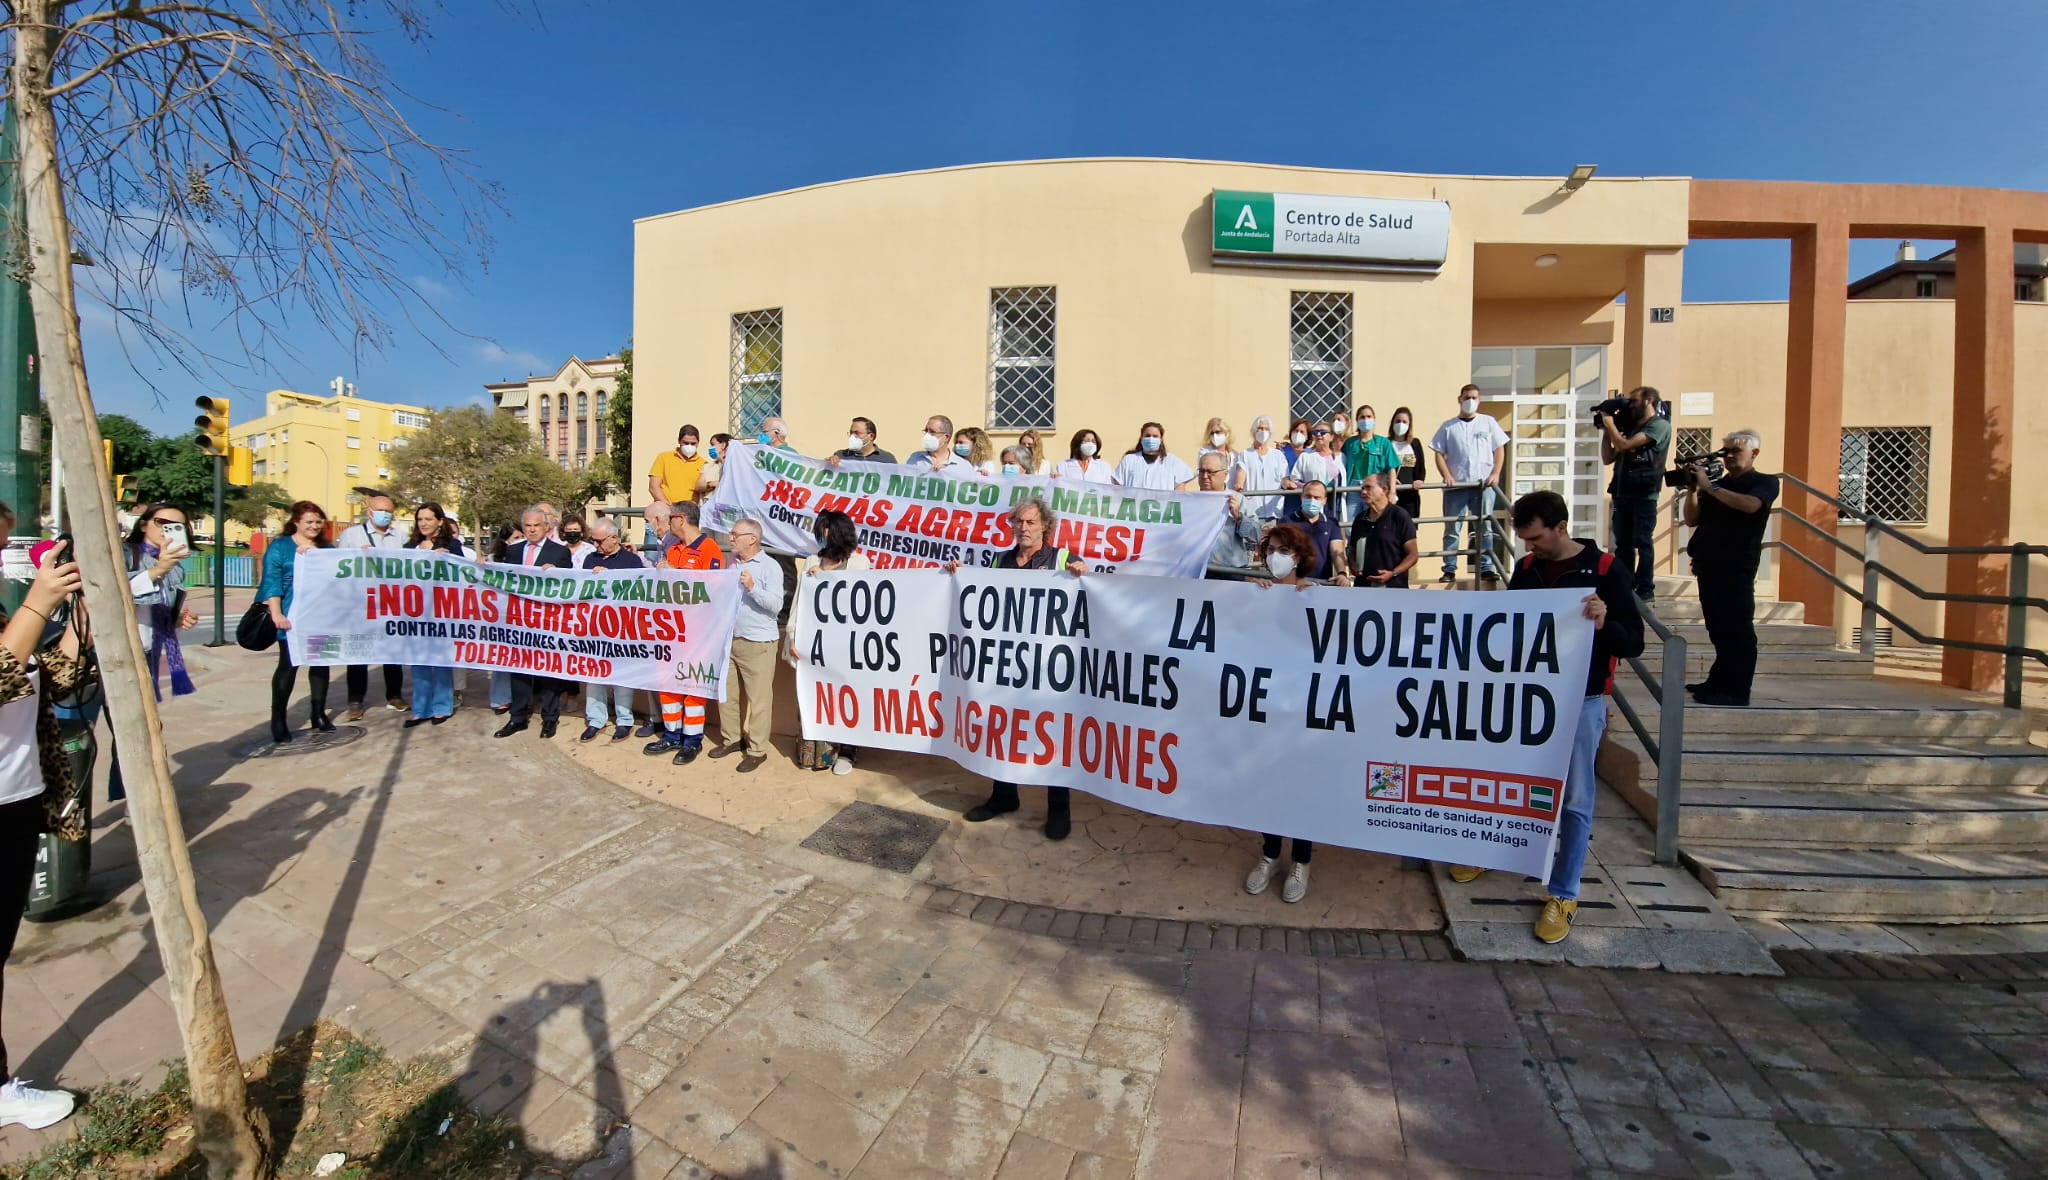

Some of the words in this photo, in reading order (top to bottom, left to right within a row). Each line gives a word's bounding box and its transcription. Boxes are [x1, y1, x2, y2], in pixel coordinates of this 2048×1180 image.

[1285, 229, 1333, 244] Portada
[1336, 231, 1360, 245] Alta
[1286, 210, 1340, 226] Centro
[1345, 212, 1364, 227] de
[1368, 213, 1413, 230] Salud
[1656, 309, 1673, 321] 12
[754, 450, 880, 494] SINDICATO
[887, 471, 1000, 507] MÉDICO
[1051, 489, 1184, 525] MÁLAGA
[769, 504, 815, 534] CONTR
[858, 529, 960, 562] AGRESIONES
[964, 548, 975, 565] A
[814, 495, 893, 528] MÁS
[896, 504, 1146, 563] AGRESNES!
[335, 556, 479, 584] SINDICATO
[482, 568, 577, 600] MÉDICO
[579, 579, 608, 601] DE
[611, 575, 712, 605] MÁLAGA
[366, 584, 424, 620] ¡NO
[432, 585, 499, 623] MÁS
[506, 594, 686, 643] AGRESIONES!
[814, 579, 896, 625] CCOO
[959, 584, 1090, 638] CONTRA
[1168, 598, 1216, 653] LA
[1305, 607, 1560, 674] VIOLENCIA
[385, 620, 447, 638] CONTRA
[450, 623, 476, 640] LAS
[479, 627, 559, 650] AGRESIONES
[558, 637, 569, 652] A
[569, 638, 672, 662] SANITARIAS-OS
[454, 641, 563, 673] TOLERANCIA
[566, 654, 612, 679] CERO
[810, 629, 826, 667] A
[850, 630, 901, 672] LOS
[929, 632, 1180, 710] PROFESIONALES
[1219, 663, 1273, 724] DE
[1306, 672, 1355, 732] LA
[1395, 676, 1556, 746] SALUD
[815, 681, 860, 729] NO
[873, 674, 945, 739] MÁS
[953, 696, 1179, 795] AGRESIONES
[1416, 773, 1525, 808] CCOO
[1367, 803, 1421, 817] sindicato
[1424, 807, 1440, 819] de
[1443, 810, 1493, 827] sanidad
[1496, 818, 1504, 829] y
[1367, 817, 1458, 837] sociosanitarios
[1461, 828, 1478, 840] de
[1481, 829, 1528, 848] Málaga
